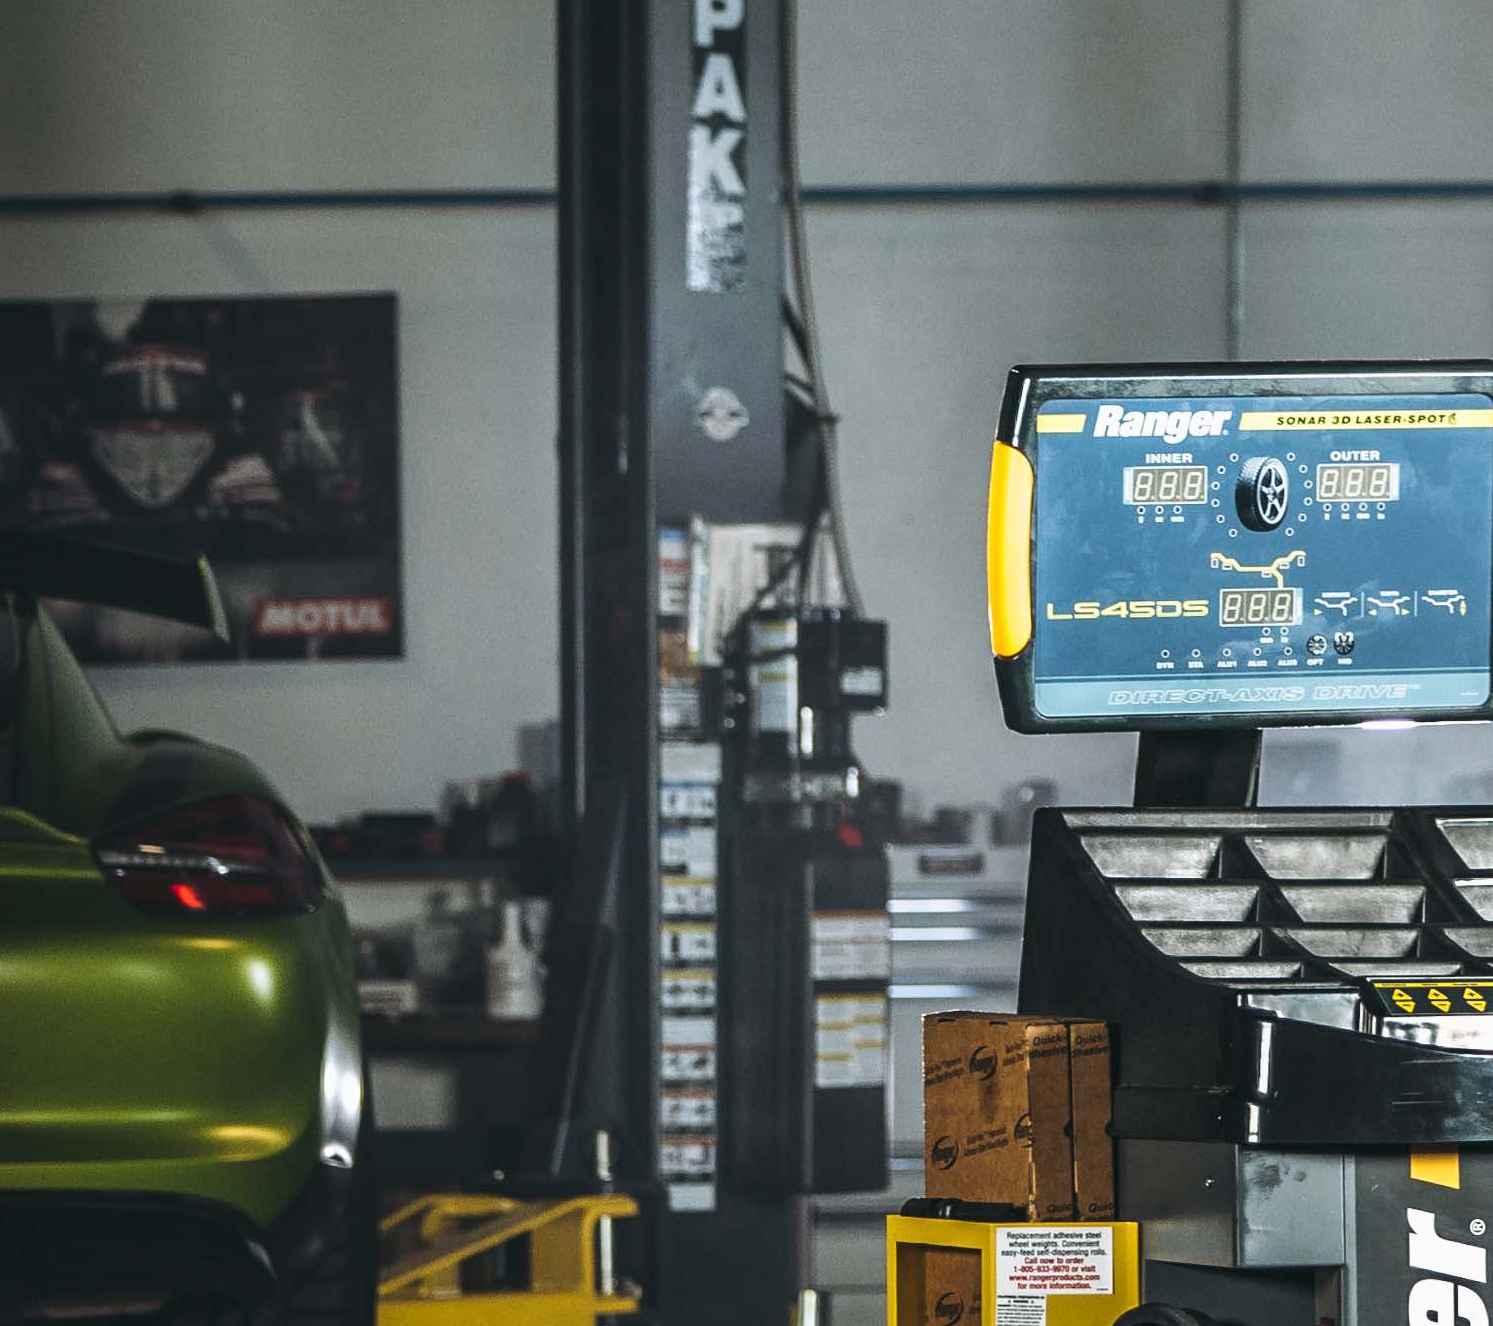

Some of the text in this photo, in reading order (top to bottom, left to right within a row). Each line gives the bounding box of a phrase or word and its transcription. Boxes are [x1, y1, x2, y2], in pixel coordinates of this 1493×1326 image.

[1276, 413, 1444, 425] SONAR 3D LASER-SPOT
[1145, 452, 1193, 464] INNER
[1330, 450, 1381, 462] OUTER
[1046, 599, 1210, 620] LS45DS
[260, 600, 386, 634] MOTUL
[1107, 687, 1304, 705] DIRECT-AXIS
[1007, 1231, 1101, 1239] Replacement adhesive steel
[1009, 1240, 1029, 1248] wheel
[1062, 1240, 1100, 1248] Convenient
[1071, 1265, 1078, 1273] or
[1081, 1265, 1096, 1273] visit
[1009, 1274, 1100, 1282] www.rangerproducts.com
